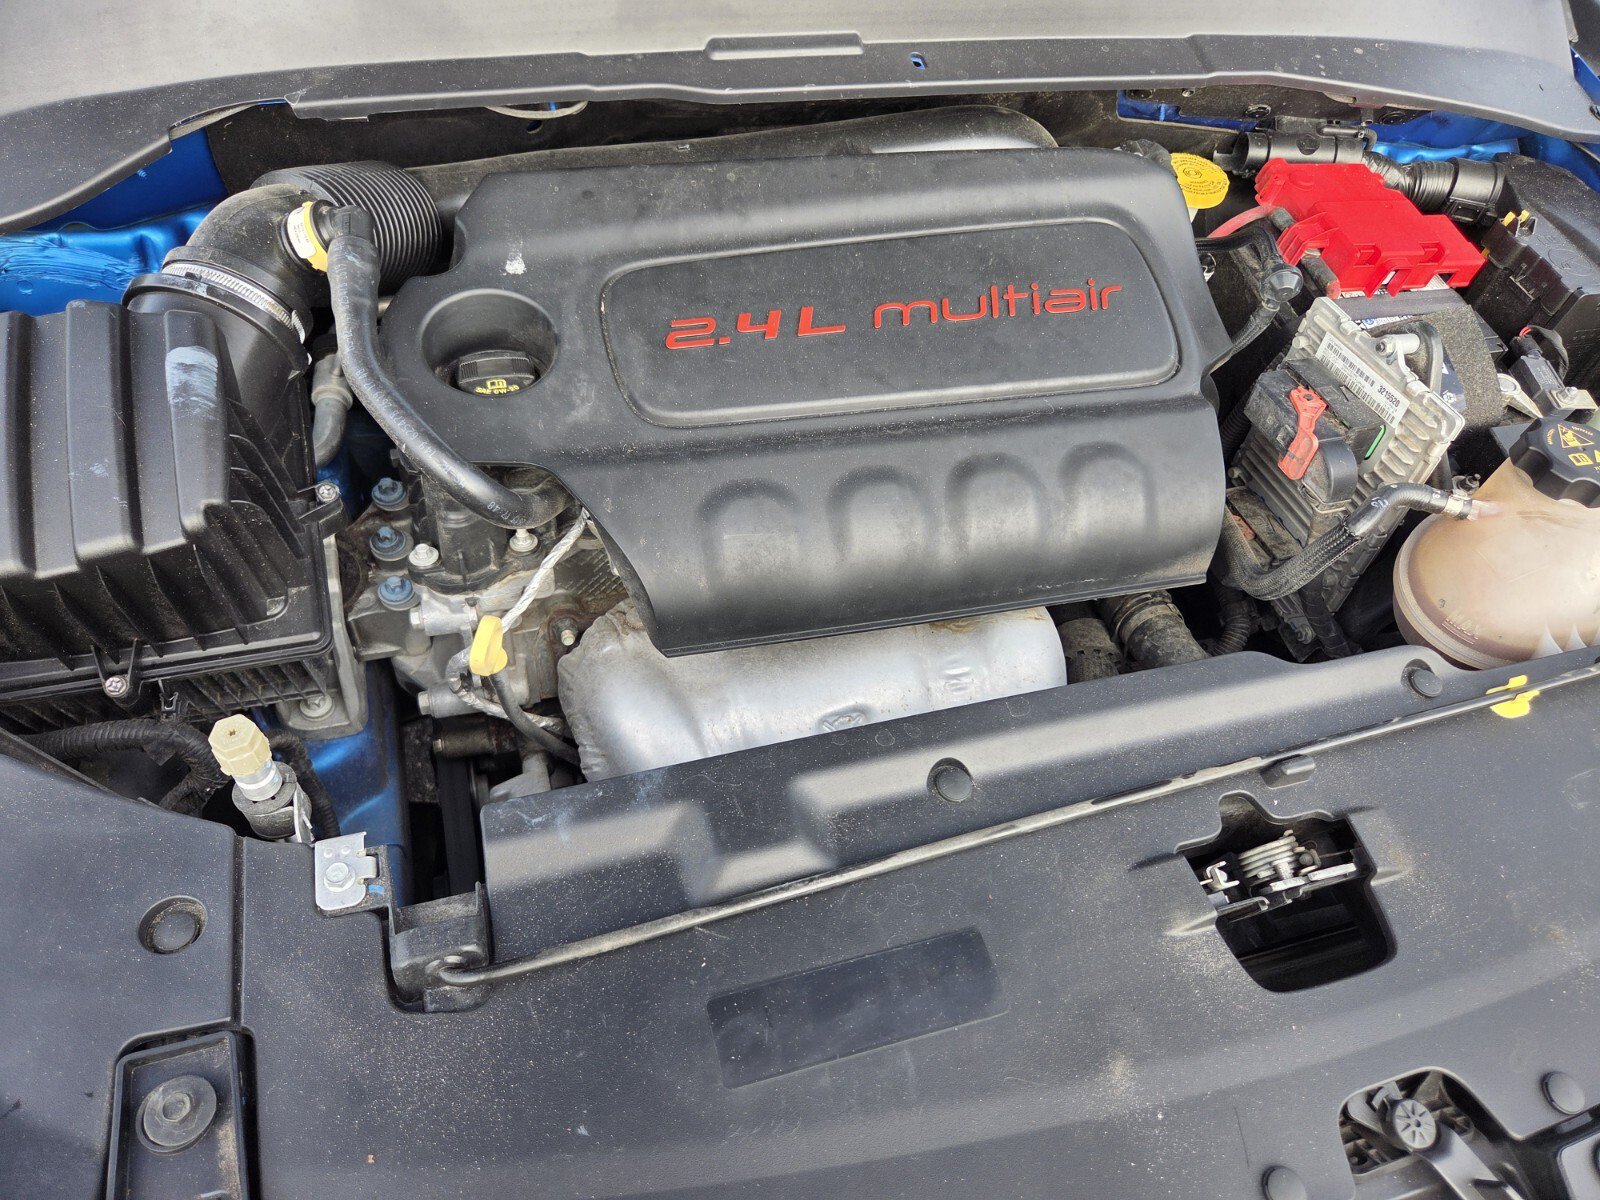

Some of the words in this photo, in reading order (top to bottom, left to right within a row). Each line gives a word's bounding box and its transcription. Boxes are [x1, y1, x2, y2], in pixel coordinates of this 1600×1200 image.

[873, 278, 1124, 329] multiair
[475, 387, 492, 395] SAE
[1375, 384, 1401, 408] 3215520
